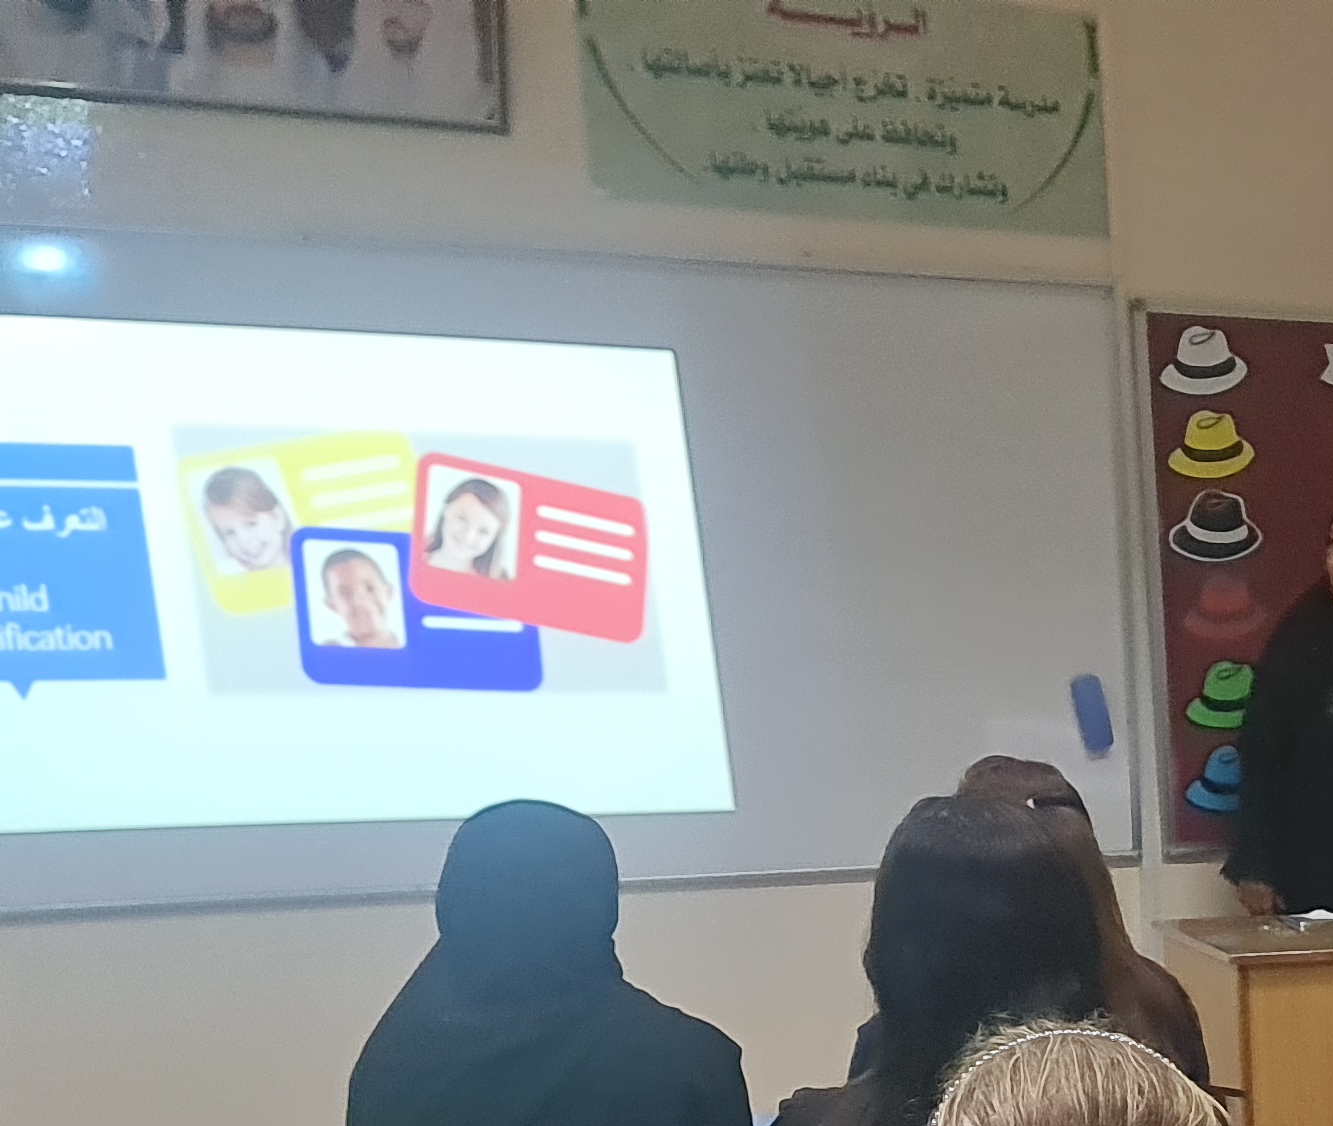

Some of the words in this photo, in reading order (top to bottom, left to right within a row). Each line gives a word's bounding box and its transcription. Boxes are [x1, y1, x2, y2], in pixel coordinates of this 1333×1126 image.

[998, 85, 1059, 117] مدرسة
[836, 116, 875, 145] على
[902, 167, 931, 200] في
[22, 504, 108, 539] التعرف
